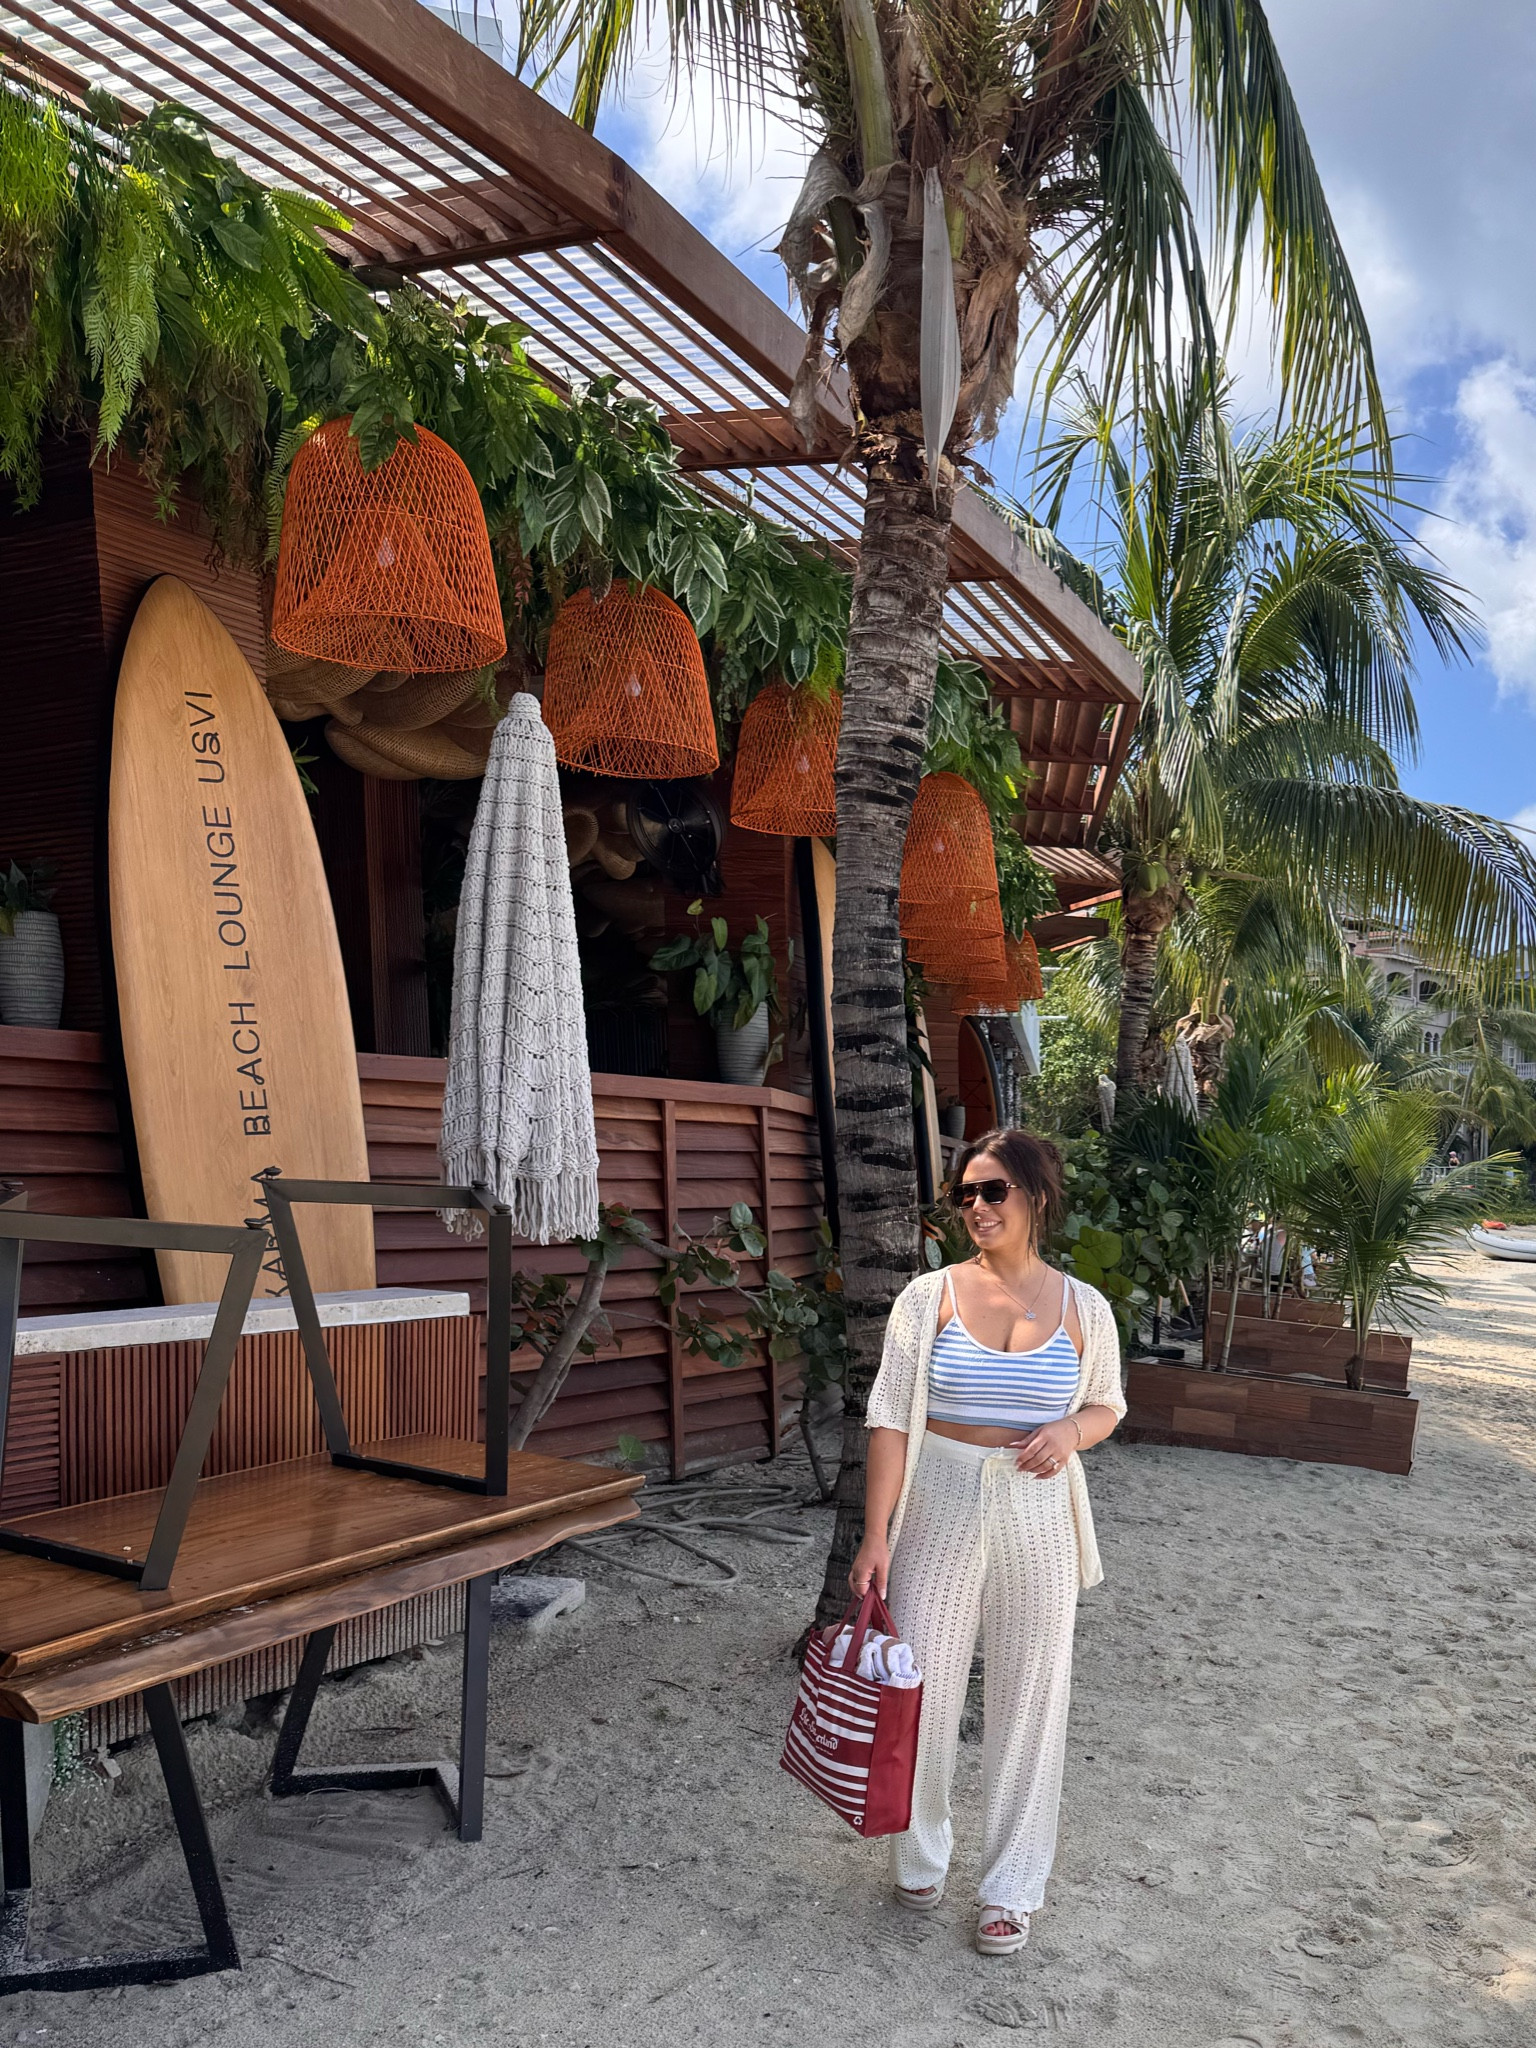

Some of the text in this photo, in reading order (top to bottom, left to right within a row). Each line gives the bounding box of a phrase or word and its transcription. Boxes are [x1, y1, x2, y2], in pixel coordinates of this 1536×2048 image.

[184, 691, 225, 784] USVI
[202, 805, 251, 970] LOUNGE
[228, 1002, 272, 1136] BEACH
